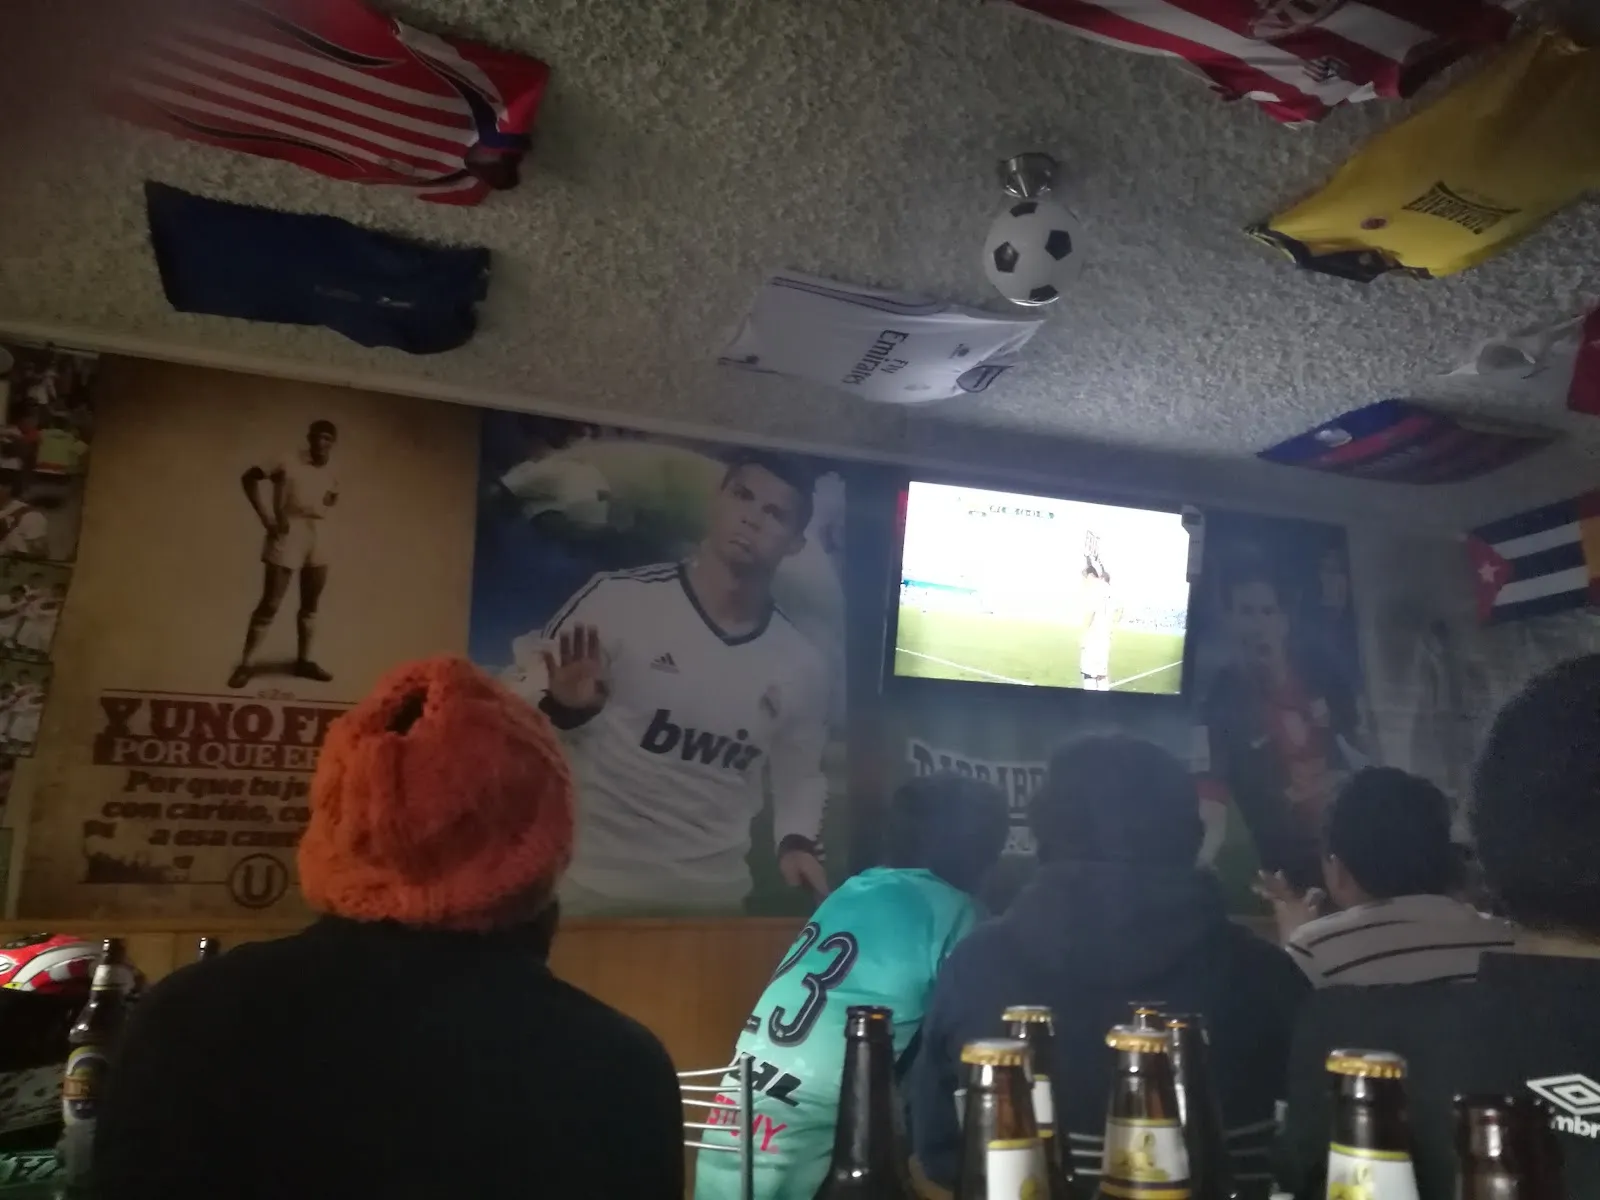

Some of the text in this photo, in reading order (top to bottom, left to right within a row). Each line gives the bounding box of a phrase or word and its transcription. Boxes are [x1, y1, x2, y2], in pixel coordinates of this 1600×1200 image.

[100, 697, 142, 736] Y
[151, 699, 274, 741] UNO
[112, 737, 191, 765] POR
[198, 741, 275, 769] QUE
[1551, 1115, 1600, 1139] mbr
